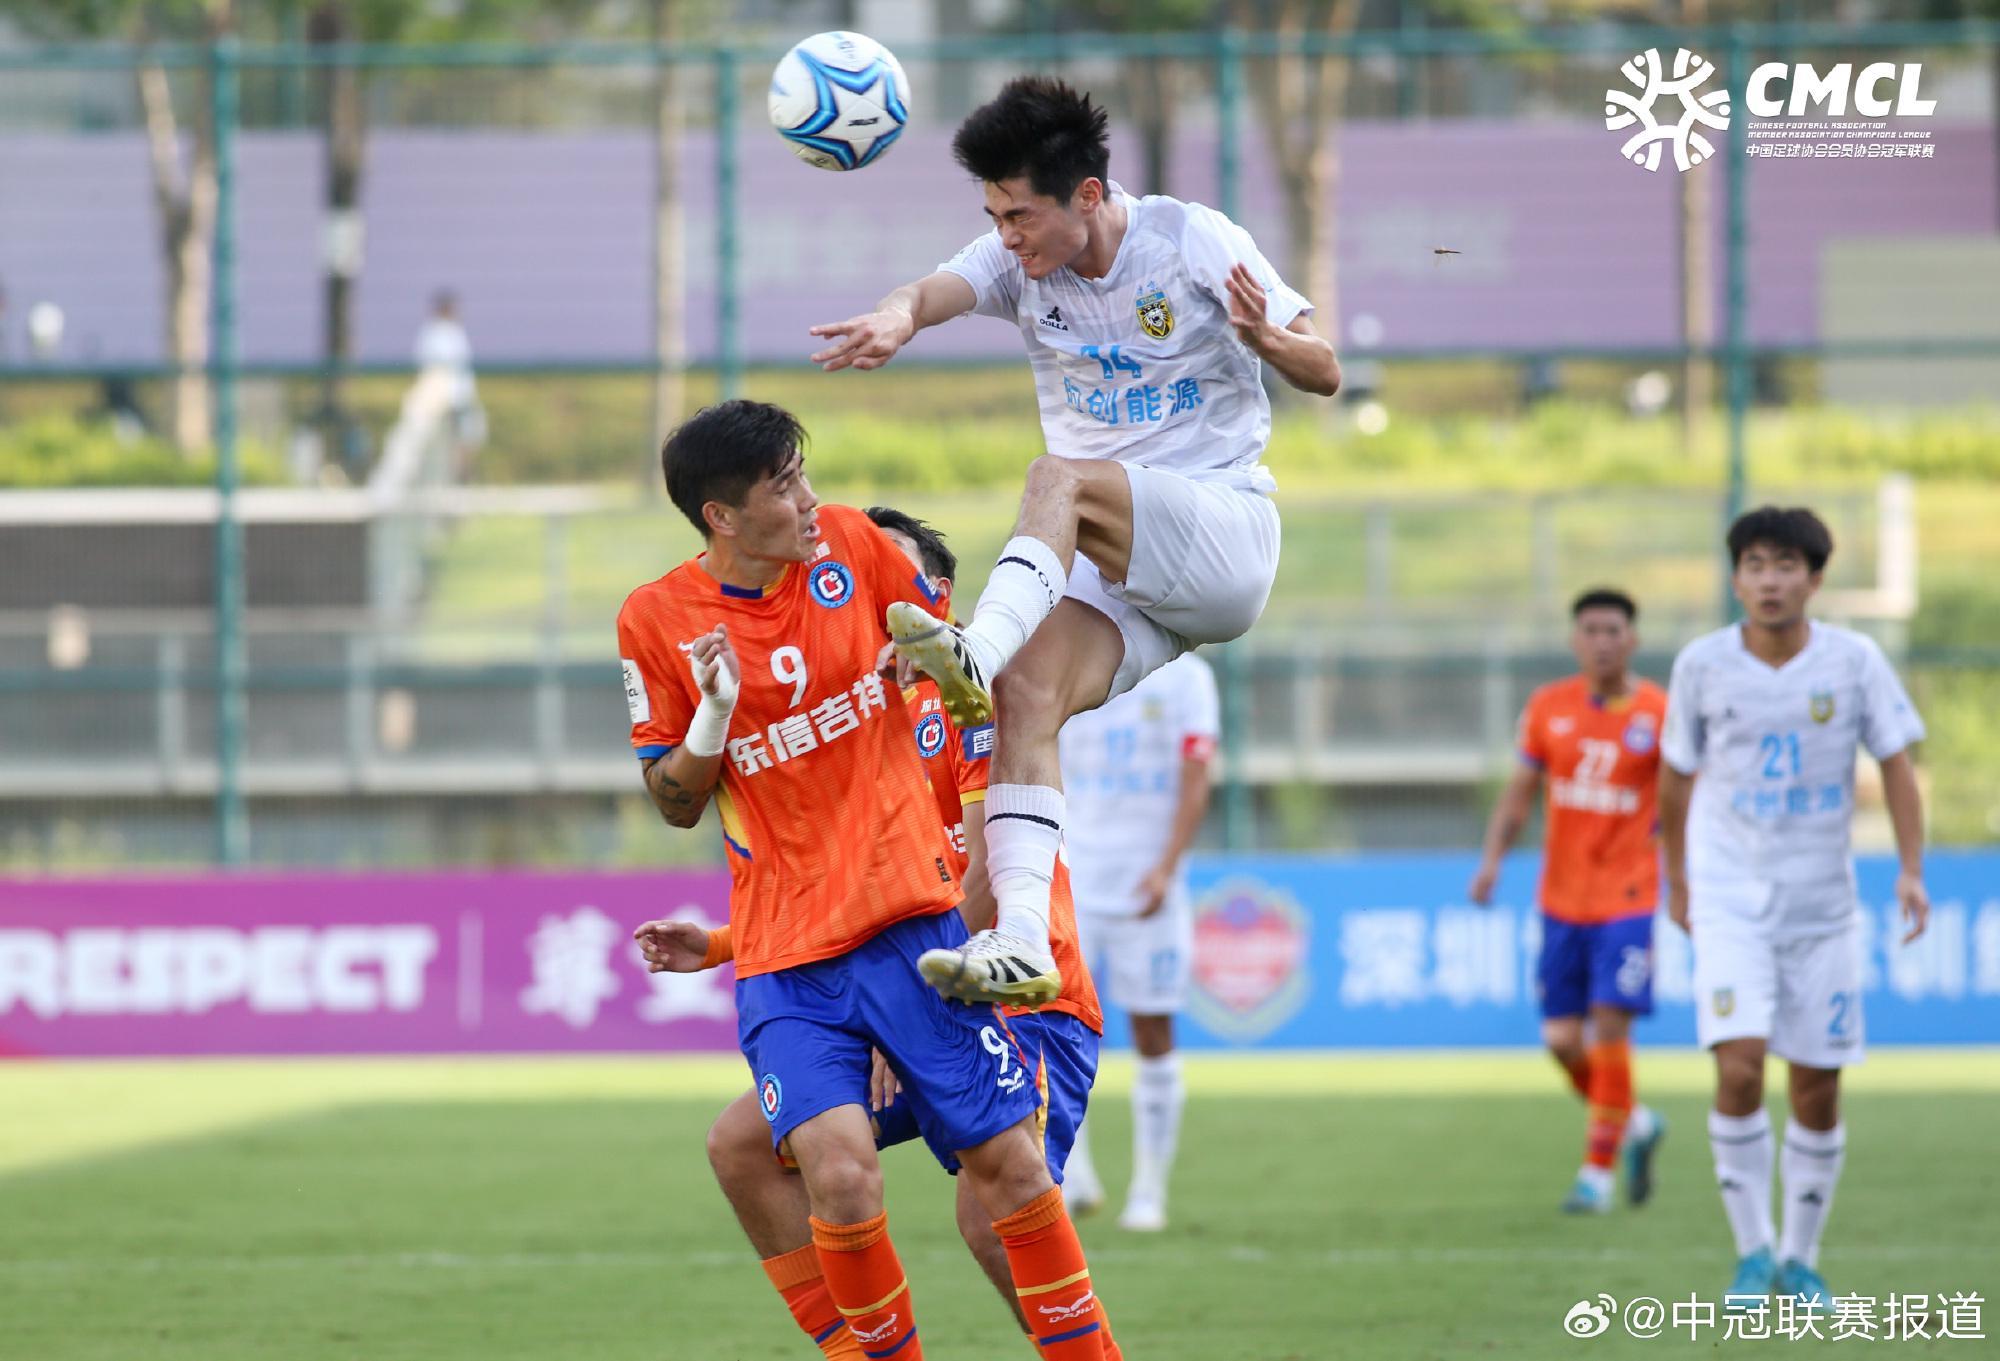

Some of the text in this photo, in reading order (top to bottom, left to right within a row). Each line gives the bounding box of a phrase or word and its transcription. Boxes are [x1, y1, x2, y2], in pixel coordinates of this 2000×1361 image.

[1081, 345, 1142, 379] 14
[770, 645, 807, 710] 9
[725, 670, 888, 777] 东信吉祥
[1760, 731, 1803, 779] 21
[0, 925, 438, 1018] RESPECT
[981, 1026, 1009, 1074] 9
